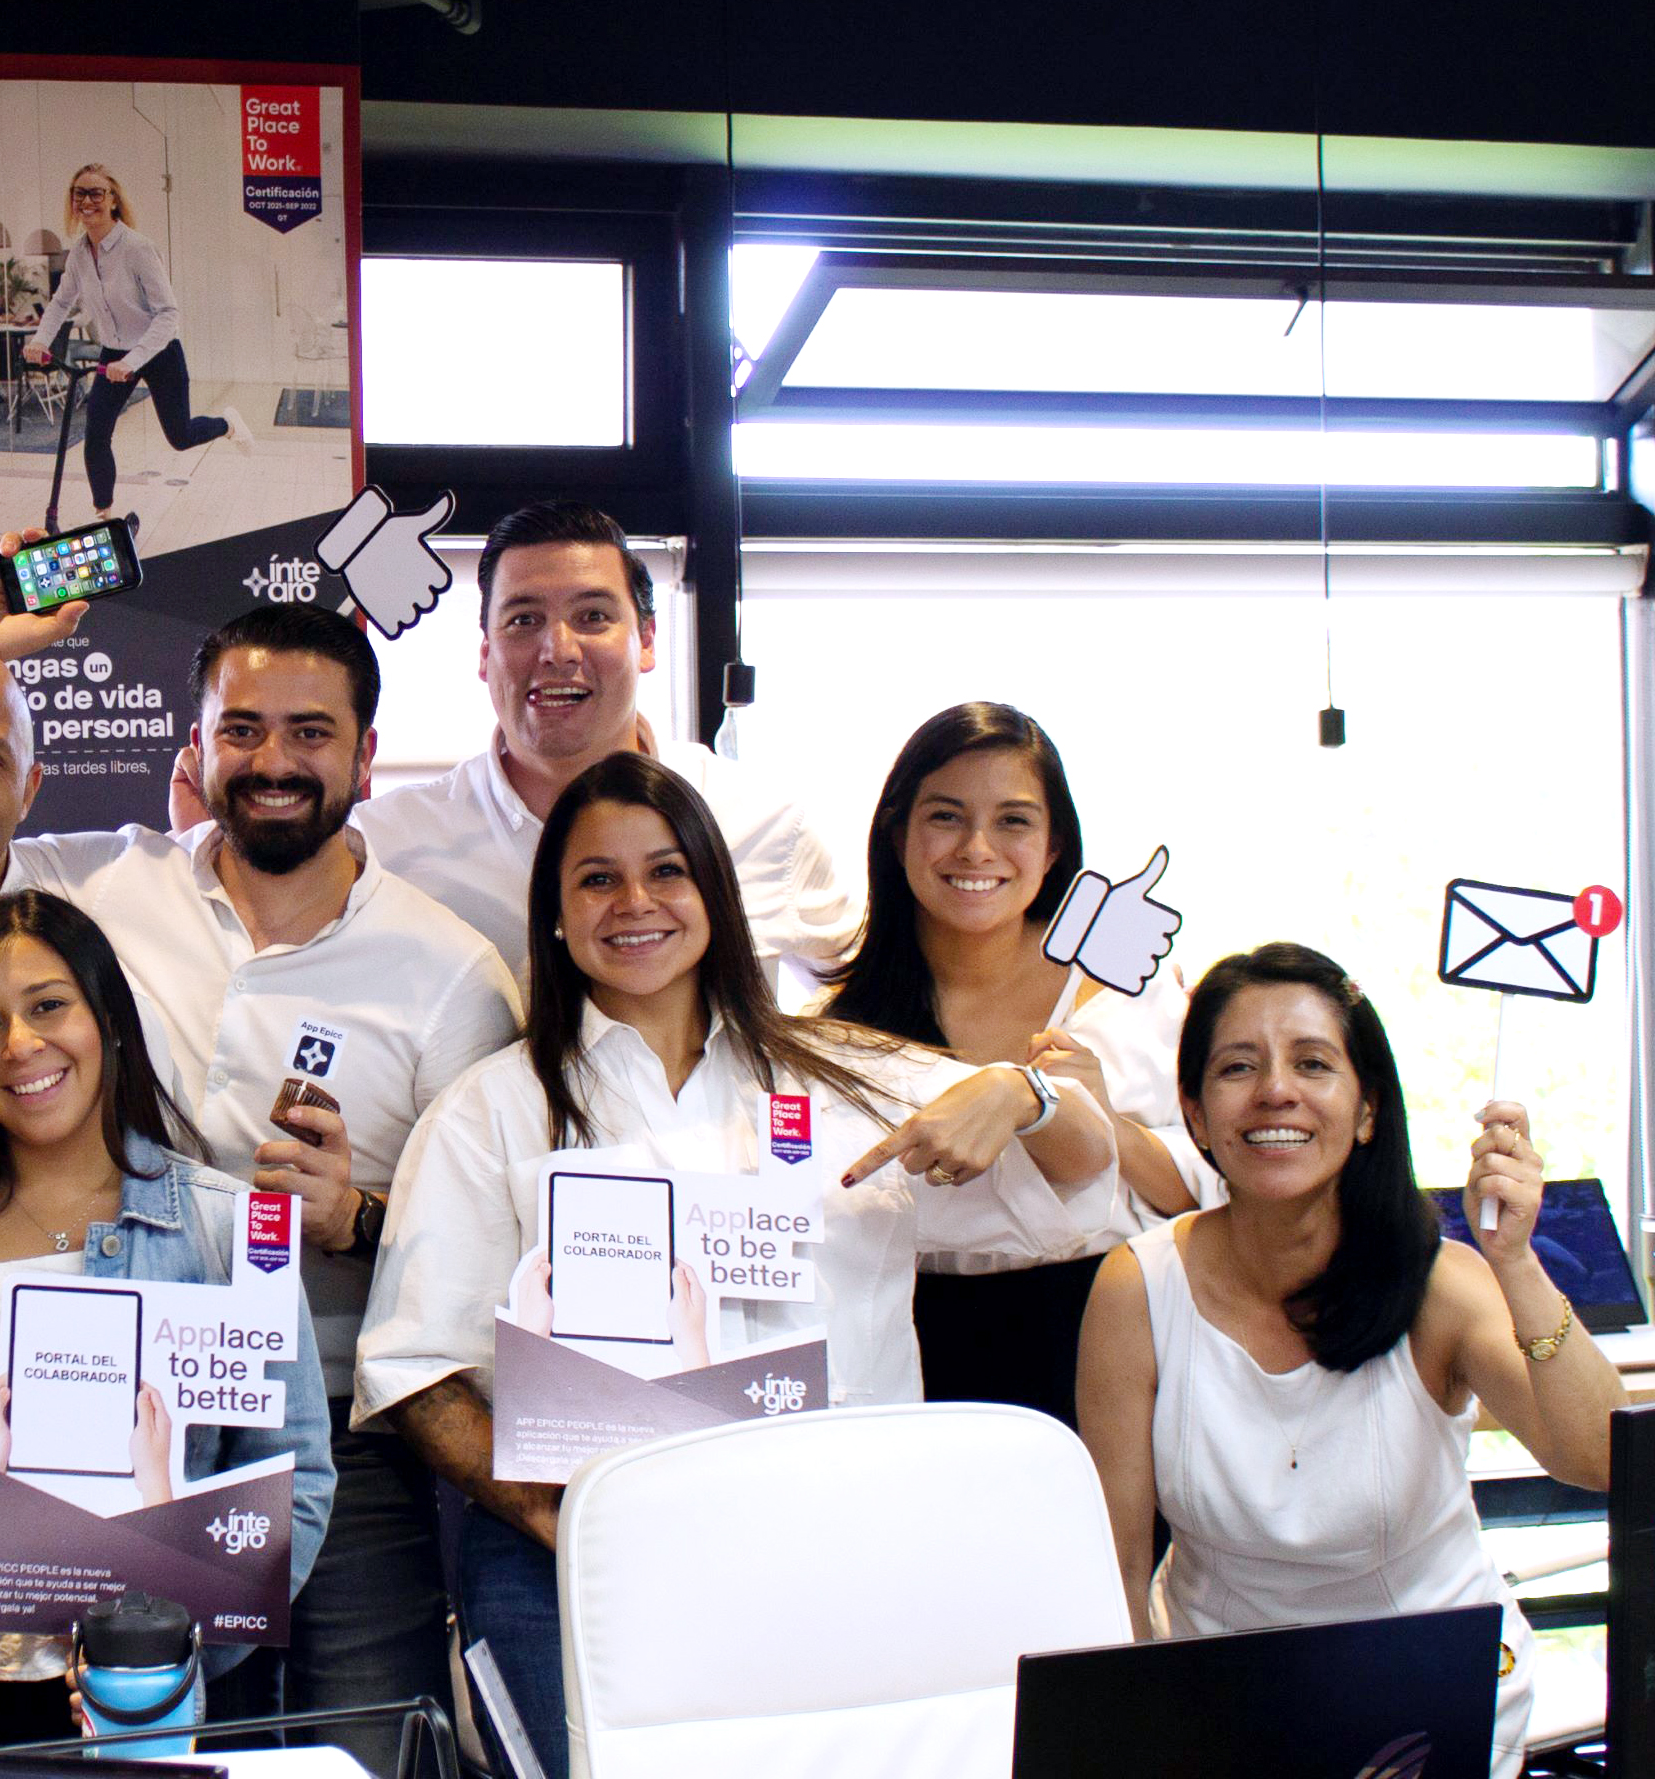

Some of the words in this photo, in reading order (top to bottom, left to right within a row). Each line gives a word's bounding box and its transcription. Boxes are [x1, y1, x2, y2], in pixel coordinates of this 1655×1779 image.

[246, 98, 301, 115] Great
[247, 117, 300, 134] Place
[247, 135, 267, 151] To
[246, 186, 319, 199] Certificación
[67, 637, 90, 649] que
[89, 663, 108, 673] un
[54, 684, 93, 711] de
[99, 683, 162, 710] vida
[43, 712, 174, 746] personal
[63, 761, 107, 776] tardes
[110, 760, 151, 776] libres,
[1588, 893, 1603, 926] 1
[301, 1021, 319, 1033] App
[319, 1026, 343, 1040] Epicc
[772, 1100, 801, 1111] Great
[772, 1110, 801, 1119] Place
[772, 1118, 784, 1127] To
[250, 1201, 281, 1212] Great
[250, 1211, 281, 1221] Place
[685, 1203, 811, 1234] Applace
[250, 1220, 263, 1230] To
[574, 1231, 624, 1244] PORTAL
[627, 1234, 652, 1246] DEL
[700, 1233, 730, 1257] to
[740, 1235, 777, 1260] be
[563, 1245, 662, 1261] COLABORADOR
[711, 1260, 801, 1288] better
[153, 1318, 284, 1352] Applace
[35, 1352, 88, 1366] PORTAL
[92, 1355, 117, 1367] DEL
[169, 1352, 199, 1378] to
[209, 1354, 247, 1380] be
[23, 1367, 127, 1384] COLABORADOR
[177, 1383, 272, 1413] better
[763, 1394, 803, 1415] gro
[516, 1417, 535, 1426] APP
[536, 1418, 565, 1428] EPICC
[566, 1420, 605, 1431] PEOPLE
[225, 1531, 266, 1555] gro
[19, 1563, 60, 1575] PEOPLE
[60, 1567, 72, 1576] es
[73, 1566, 82, 1576] la
[83, 1568, 112, 1578] nueva
[15, 1578, 34, 1588] que
[34, 1578, 45, 1587] te
[46, 1579, 74, 1590] ayuda
[75, 1581, 82, 1589] a
[83, 1582, 98, 1590] ser
[99, 1582, 126, 1593] mejor
[14, 1590, 24, 1599] tu
[25, 1591, 52, 1603] mejor
[53, 1592, 98, 1604] potencial.
[213, 1614, 268, 1630] #EPICC
